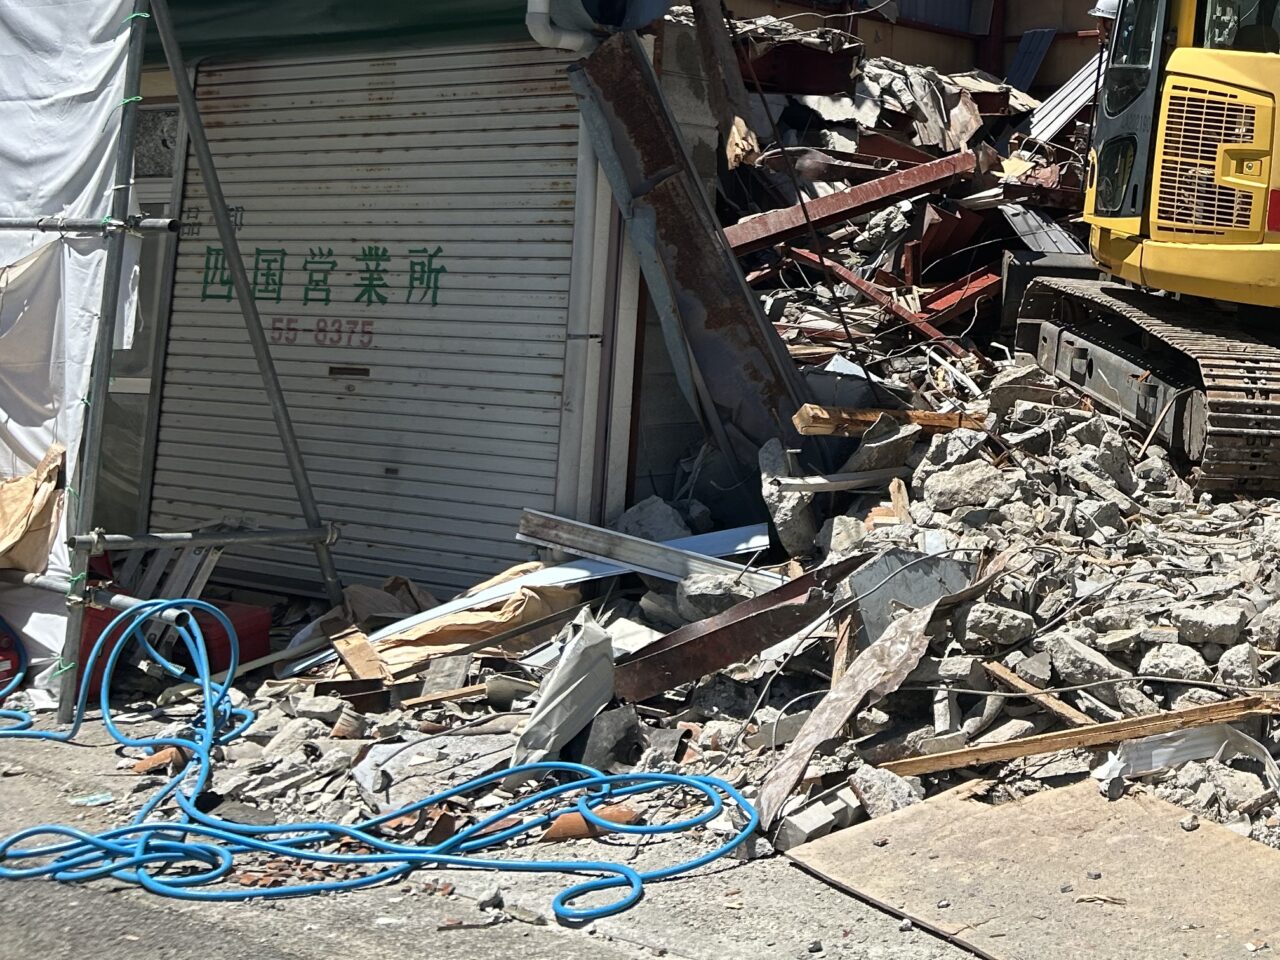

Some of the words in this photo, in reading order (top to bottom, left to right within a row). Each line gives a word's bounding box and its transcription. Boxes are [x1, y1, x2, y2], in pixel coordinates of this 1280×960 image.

[200, 245, 448, 308] 四国営業所
[270, 317, 375, 348] 55-8375
